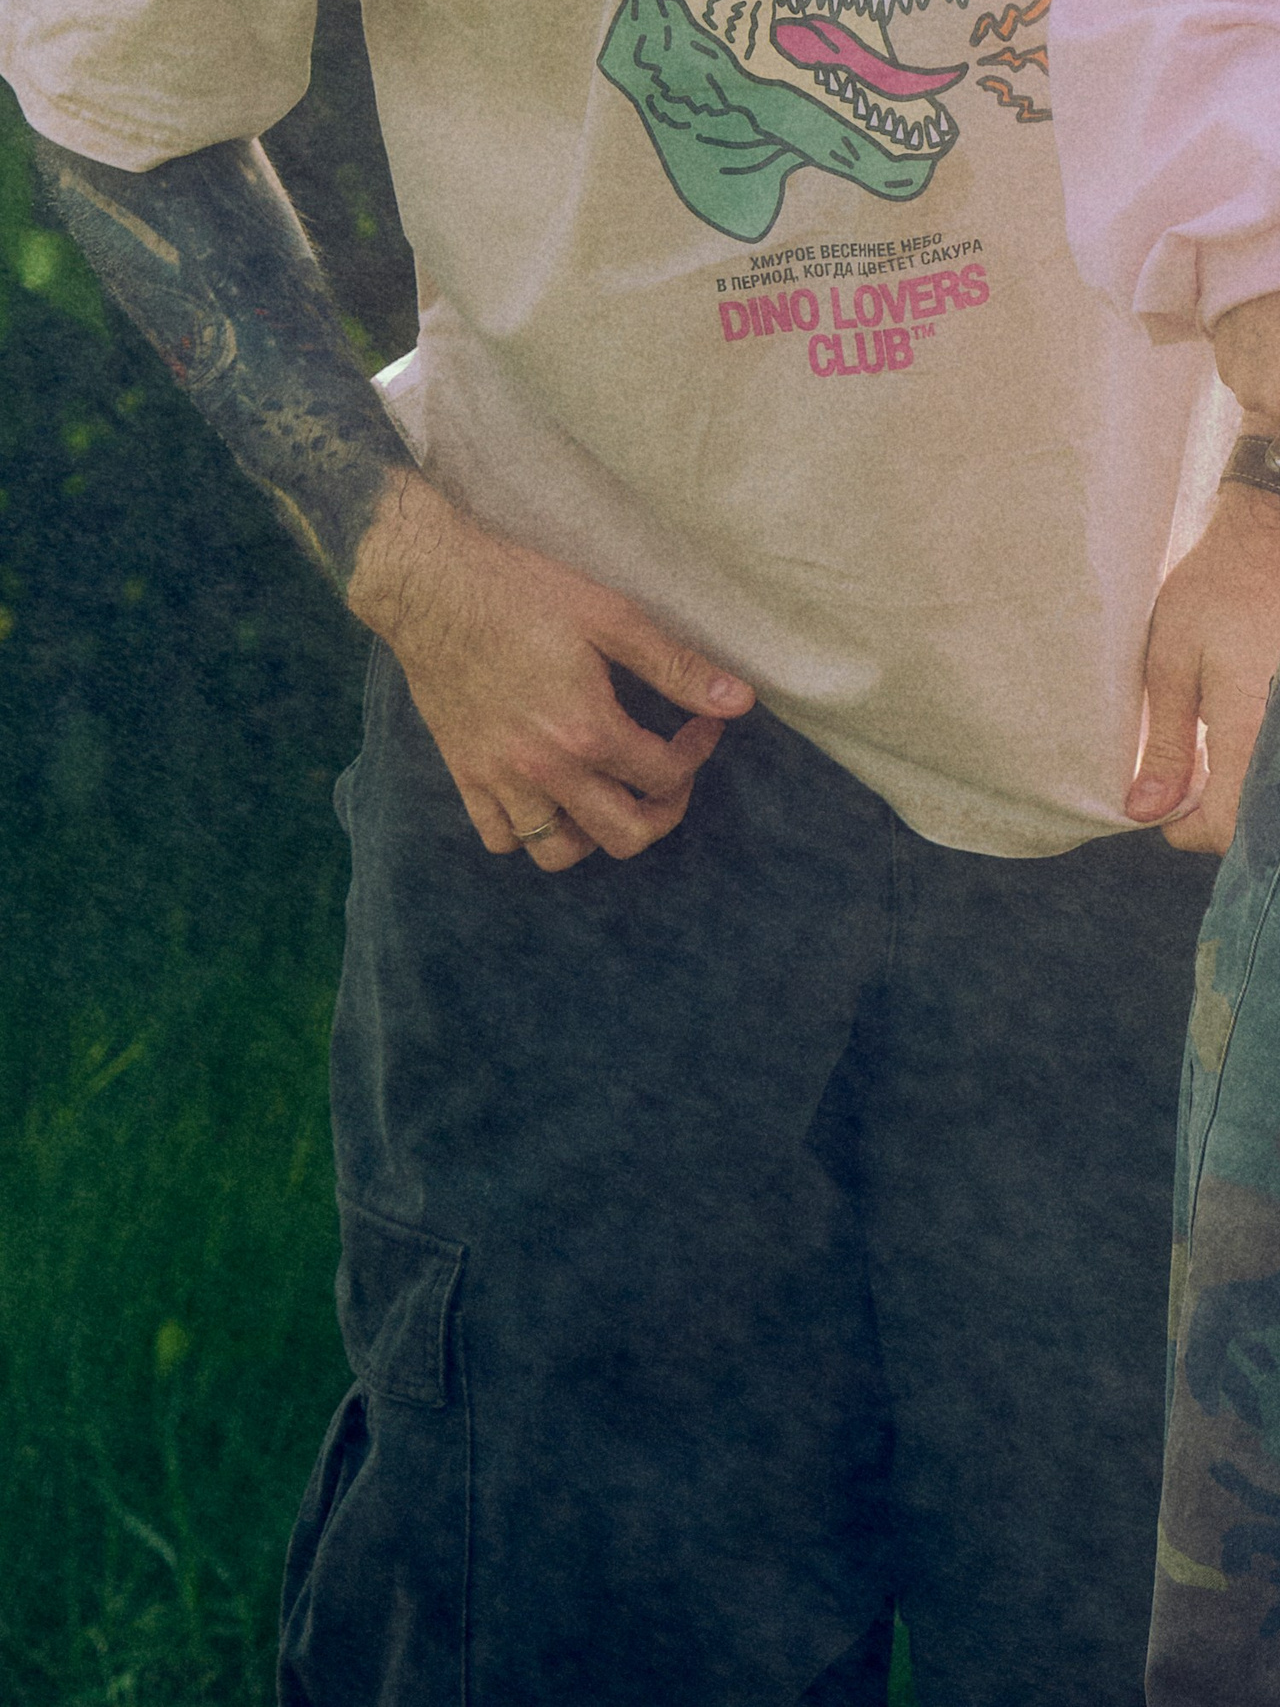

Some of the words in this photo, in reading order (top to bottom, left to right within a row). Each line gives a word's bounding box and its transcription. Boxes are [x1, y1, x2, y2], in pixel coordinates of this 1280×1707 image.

[716, 278, 728, 292] В
[731, 267, 799, 292] ПЕРИОД,
[804, 261, 854, 279] КОГДА
[857, 255, 915, 277] ЦВЕТЕТ
[920, 238, 984, 266] САКУРА
[750, 245, 816, 271] ХМУРОЕ
[821, 241, 896, 260] ВЕСЕННЕЕ
[901, 232, 943, 253] НЕБО
[718, 288, 820, 343] DINO
[830, 263, 991, 331] LOVERS
